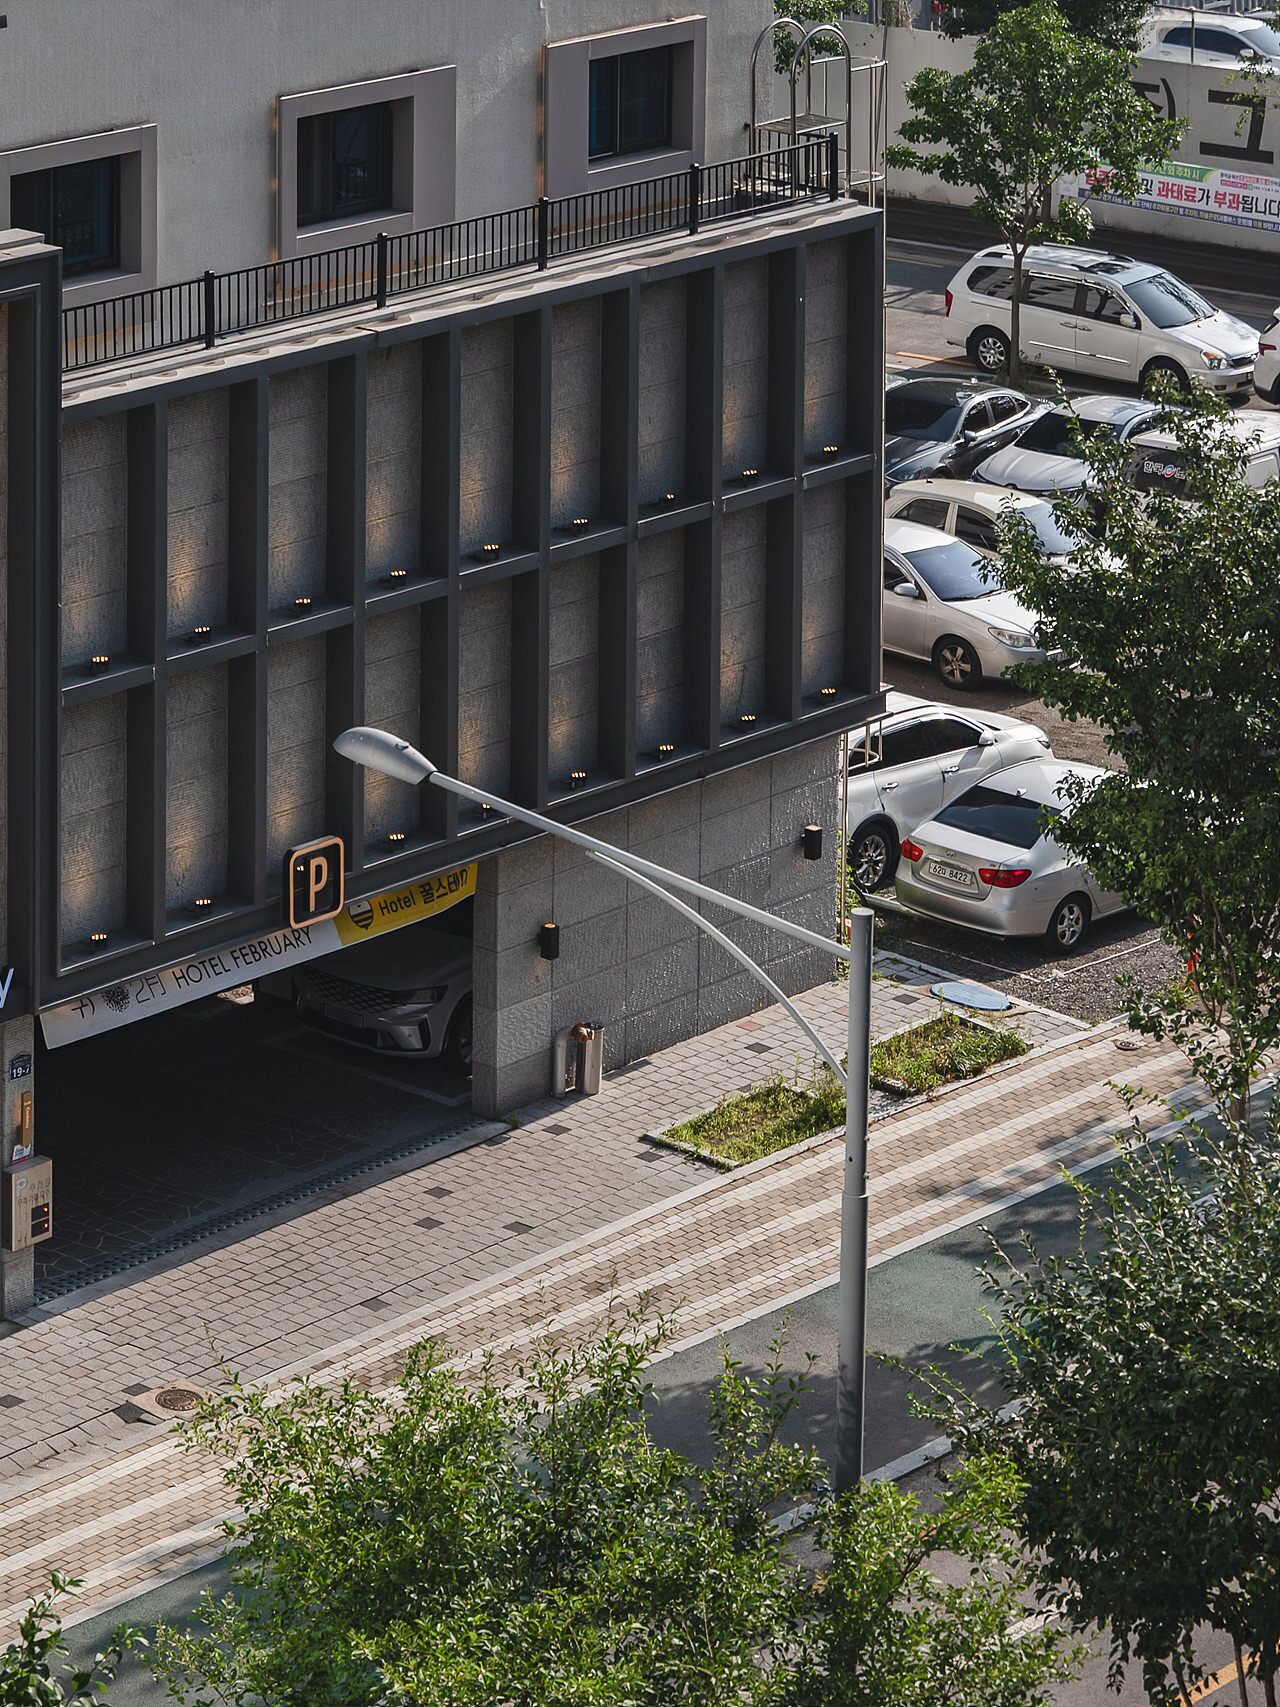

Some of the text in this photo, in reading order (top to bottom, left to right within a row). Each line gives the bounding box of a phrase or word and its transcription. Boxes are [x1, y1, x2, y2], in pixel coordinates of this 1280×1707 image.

[1156, 180, 1211, 206] 과태료가
[308, 855, 328, 912] P
[948, 870, 968, 882] 8422
[174, 955, 230, 990] HOTEL
[232, 927, 313, 969] FEBRUARY
[378, 890, 416, 916] Hotel
[12, 1064, 30, 1078] 19-7
